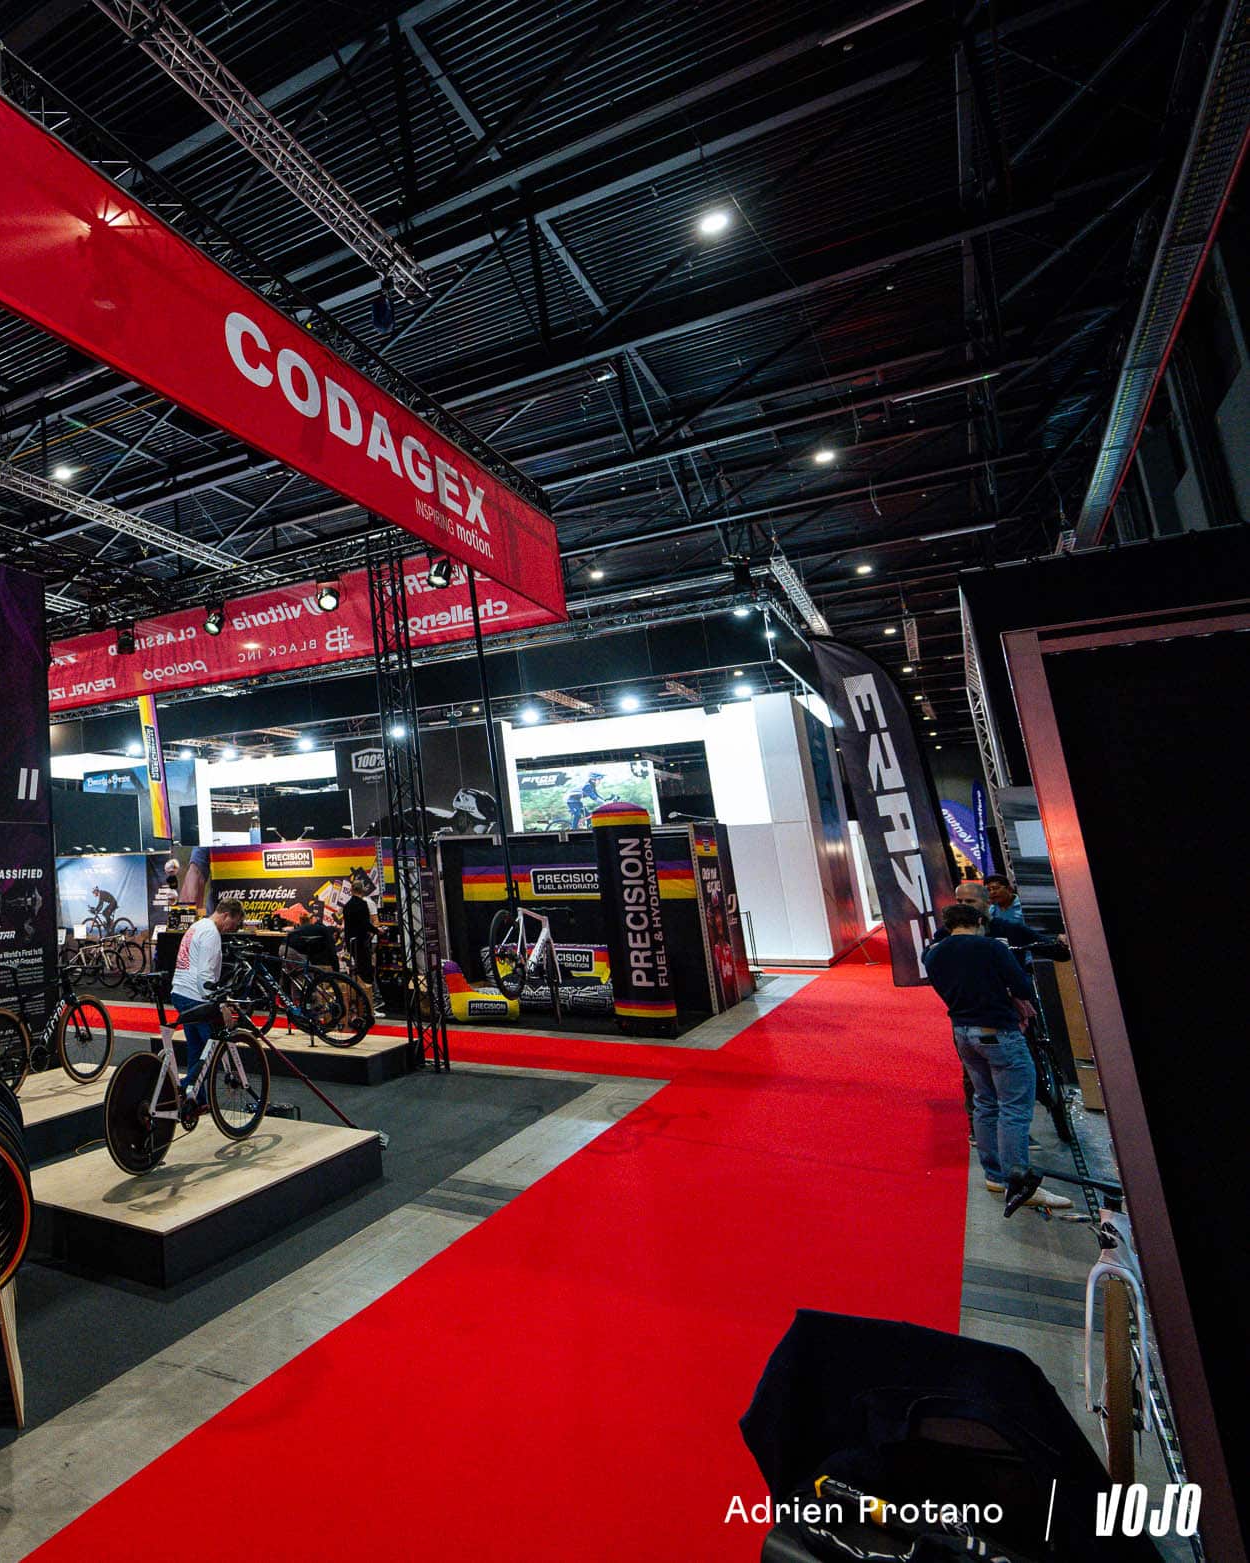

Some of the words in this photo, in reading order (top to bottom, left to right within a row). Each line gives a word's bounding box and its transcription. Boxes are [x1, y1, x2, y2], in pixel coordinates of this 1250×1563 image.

[225, 312, 491, 535] CODAGEX
[415, 497, 455, 536] INSPIRING
[456, 522, 494, 561] motion.
[266, 852, 310, 862] PRECISION
[643, 837, 662, 929] HYDRATION
[218, 889, 246, 900] VOTRE
[249, 886, 297, 899] STRATÉGIE
[617, 838, 656, 988] PRECISION
[656, 957, 669, 987] FUEL
